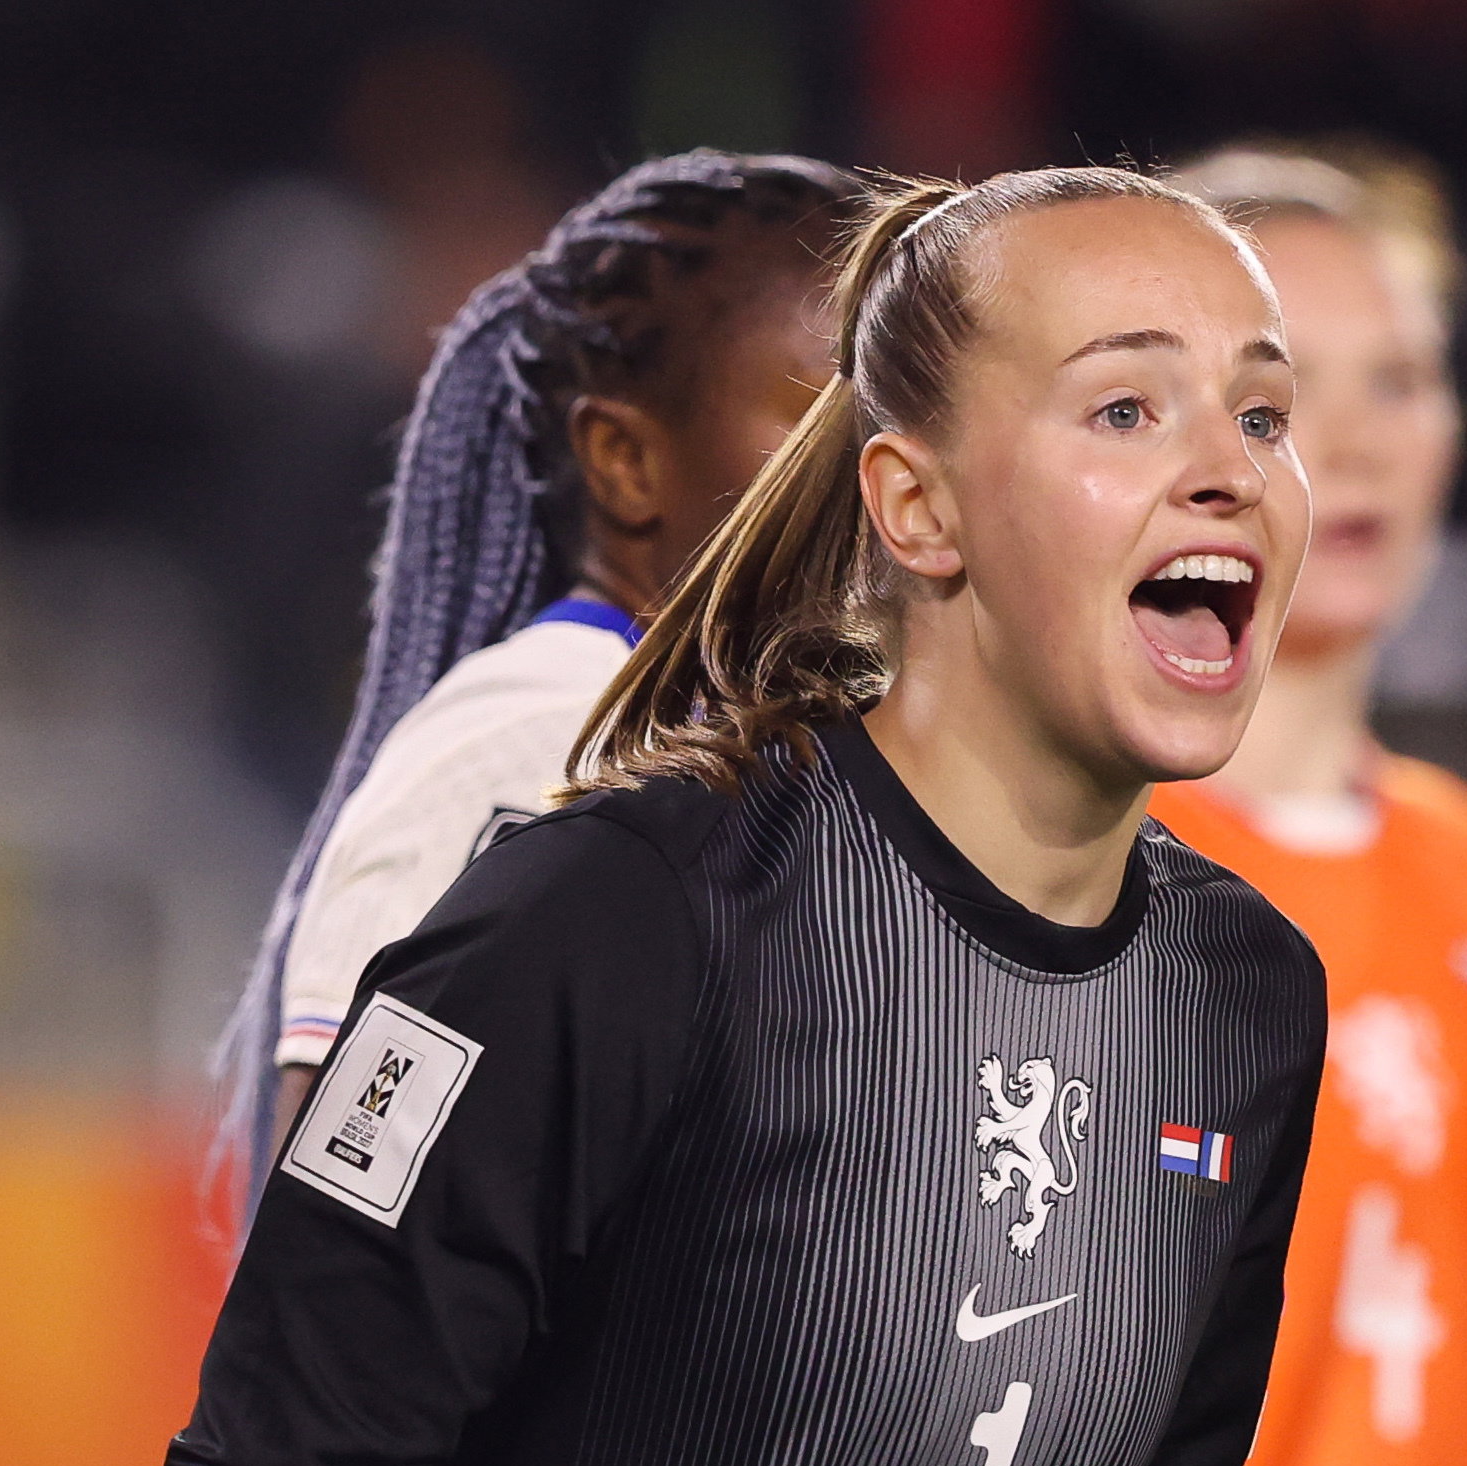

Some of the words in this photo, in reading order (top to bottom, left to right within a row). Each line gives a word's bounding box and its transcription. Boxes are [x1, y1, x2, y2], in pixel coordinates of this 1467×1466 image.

[359, 1111, 373, 1122] FIFA
[345, 1121, 363, 1135] WORLD
[364, 1131, 376, 1140] CUP
[1334, 1182, 1449, 1444] 4
